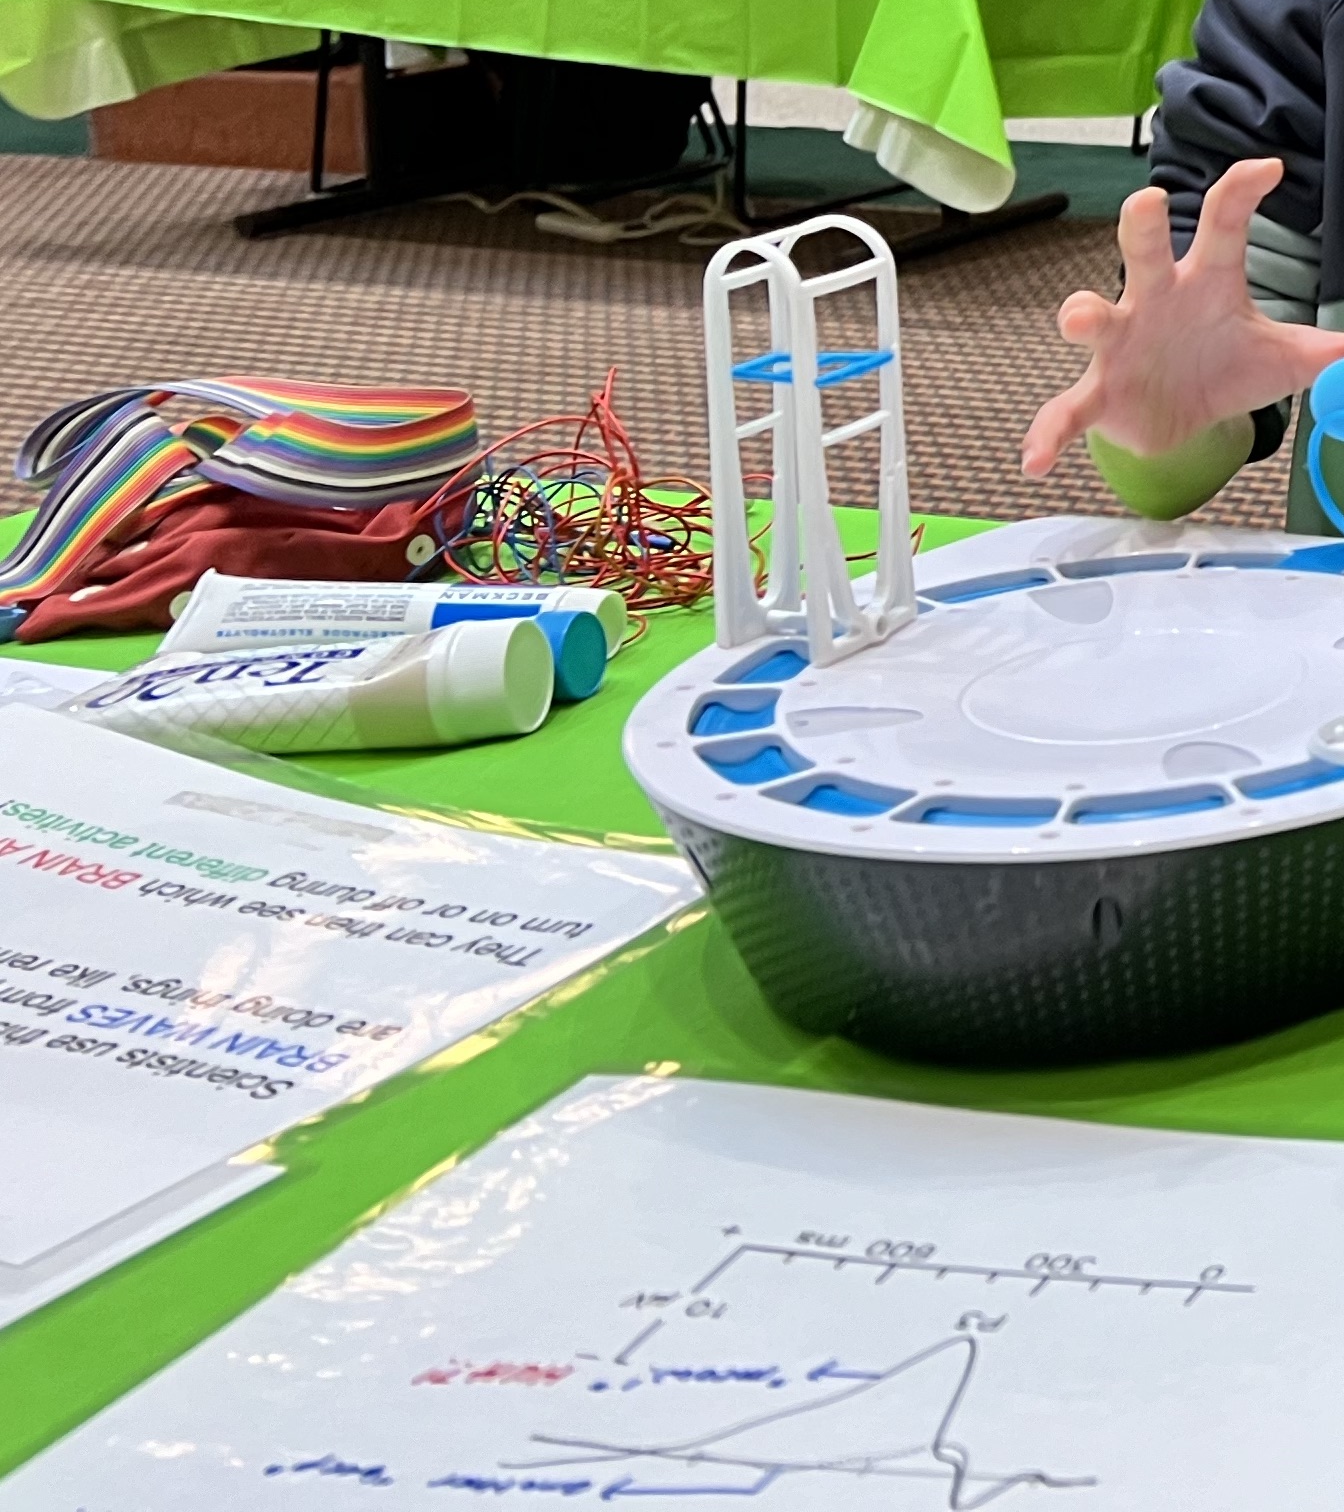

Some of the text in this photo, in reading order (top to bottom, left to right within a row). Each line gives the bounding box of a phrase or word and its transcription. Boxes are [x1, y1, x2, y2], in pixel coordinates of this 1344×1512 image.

[438, 591, 549, 601] BECKMAN
[17, 849, 143, 890] BRAIN
[128, 842, 269, 884] different
[138, 878, 238, 908] which
[266, 871, 377, 904] during
[237, 900, 306, 921] see
[362, 894, 425, 912] off
[421, 902, 467, 918] or
[304, 912, 385, 939] then
[469, 908, 518, 927] on
[519, 916, 593, 939] turn
[385, 926, 453, 948] can
[451, 935, 543, 967] They
[48, 963, 117, 989] like
[66, 1004, 219, 1046] WAVES
[232, 995, 335, 1030] doing
[336, 1019, 403, 1041] are
[46, 1034, 119, 1057] use
[209, 1032, 350, 1073] BRAIN
[116, 1048, 295, 1100] Scientists
